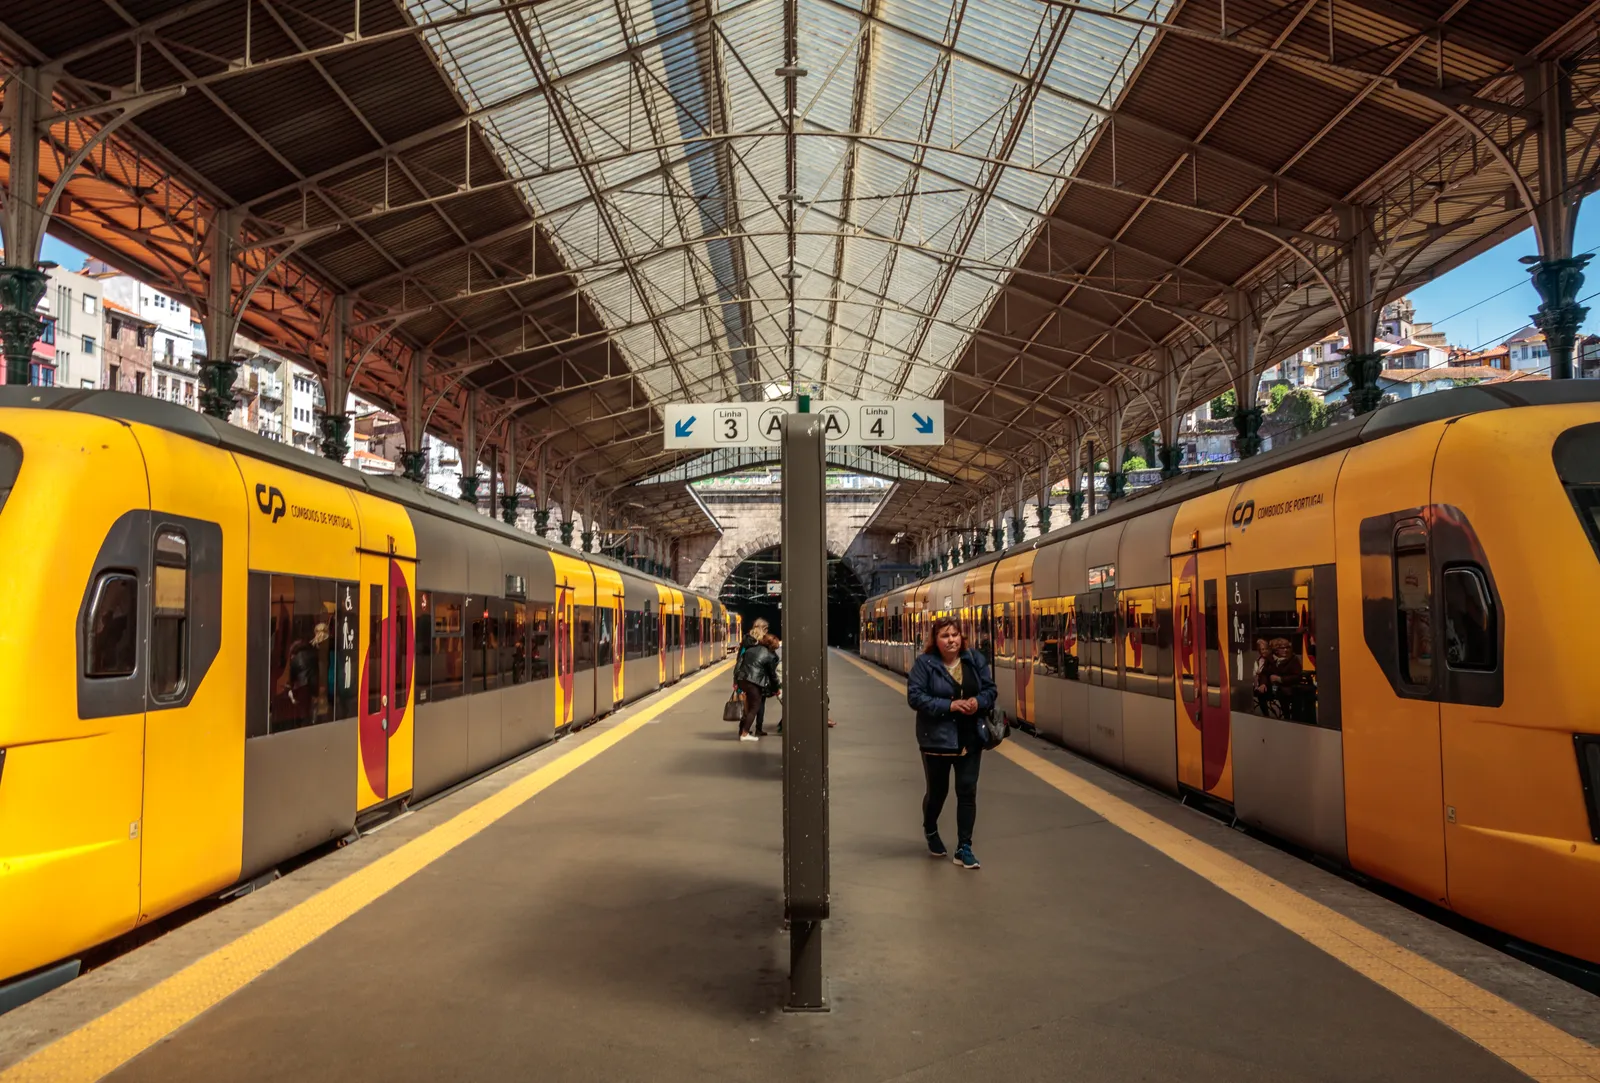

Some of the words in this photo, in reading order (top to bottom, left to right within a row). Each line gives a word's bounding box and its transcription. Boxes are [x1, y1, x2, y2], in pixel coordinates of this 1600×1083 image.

[724, 418, 738, 439] 3
[766, 415, 782, 435] A
[825, 414, 842, 434] A
[870, 418, 884, 438] 4
[291, 505, 319, 523] COMBOIOS
[320, 511, 328, 524] DE
[328, 513, 353, 530] PORTUGAL
[1257, 503, 1284, 520] COMBOIOS
[1285, 501, 1293, 514] DE
